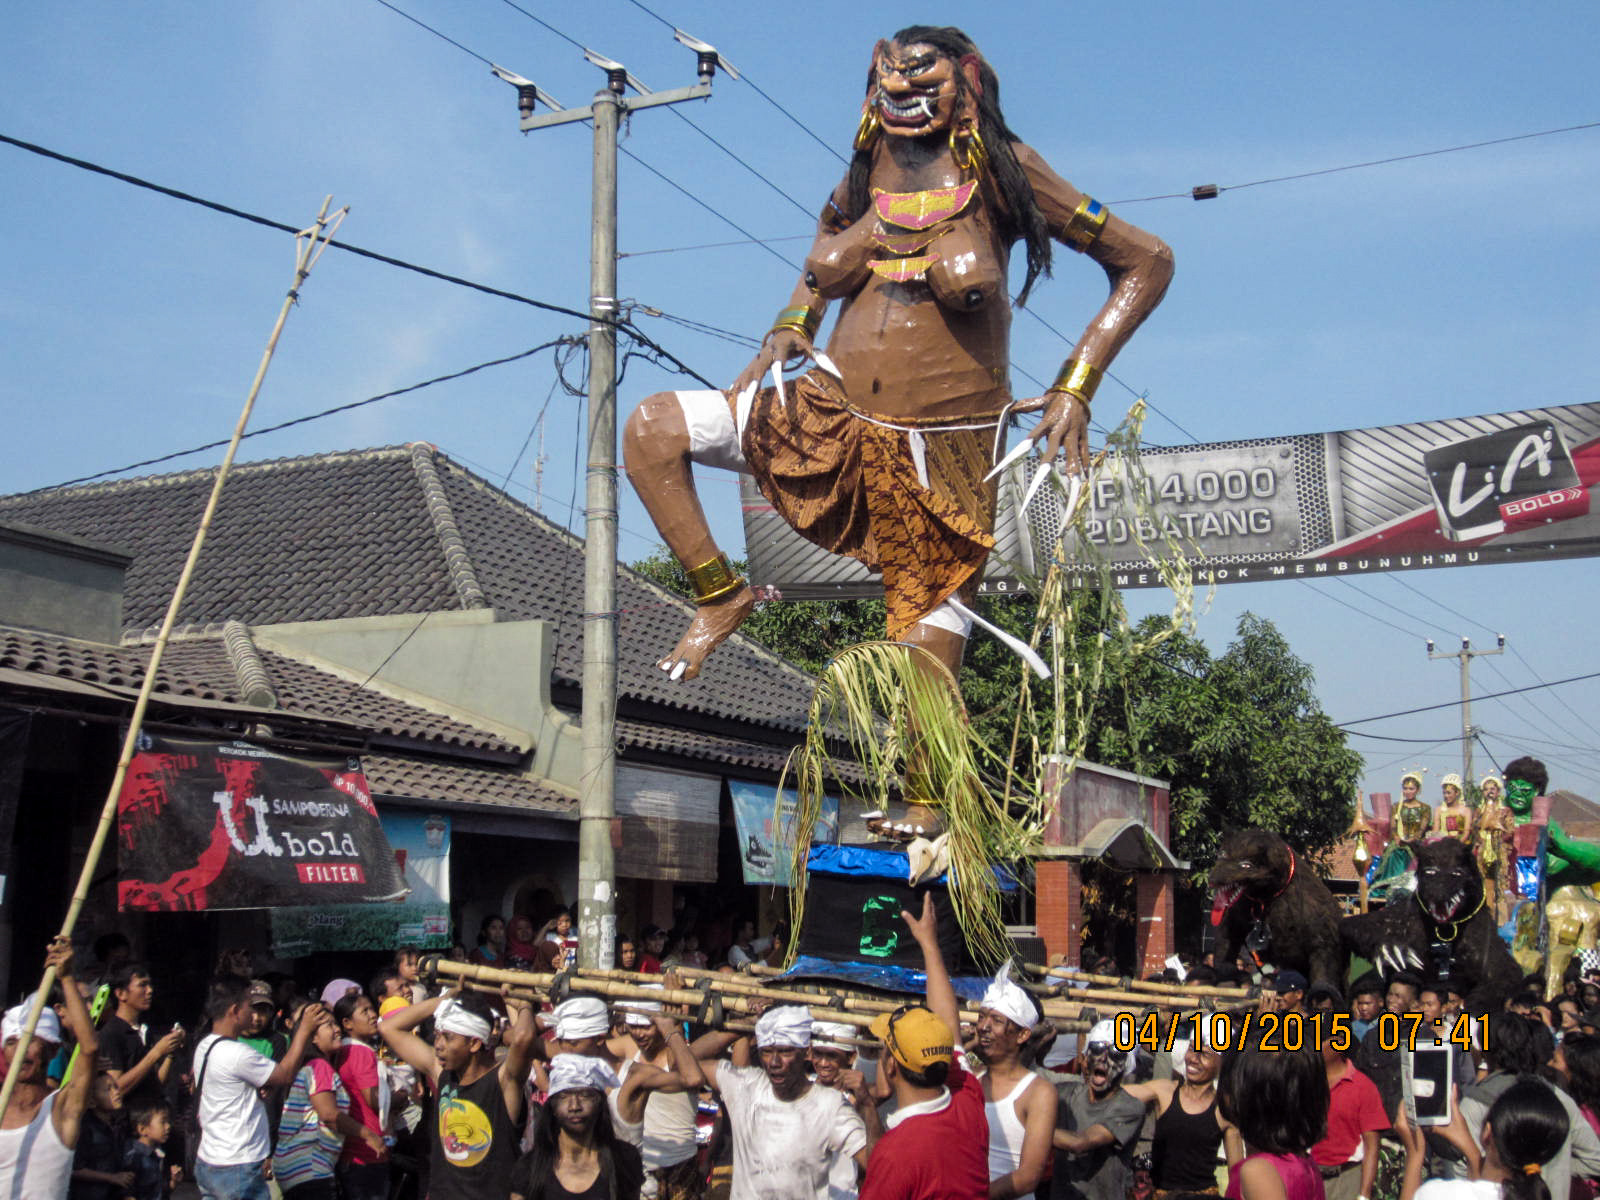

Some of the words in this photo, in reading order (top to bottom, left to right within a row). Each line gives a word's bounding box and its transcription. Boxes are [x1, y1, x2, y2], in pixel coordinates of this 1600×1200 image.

[1143, 467, 1275, 504] 14.000
[1505, 492, 1565, 516] BOLD
[1085, 517, 1128, 544] 20
[1134, 508, 1272, 543] BATANG
[1273, 551, 1479, 576] MEMBUNUHMU
[273, 799, 350, 817] SAMPOERNA
[281, 831, 359, 857] bold
[306, 865, 360, 882] FILTER
